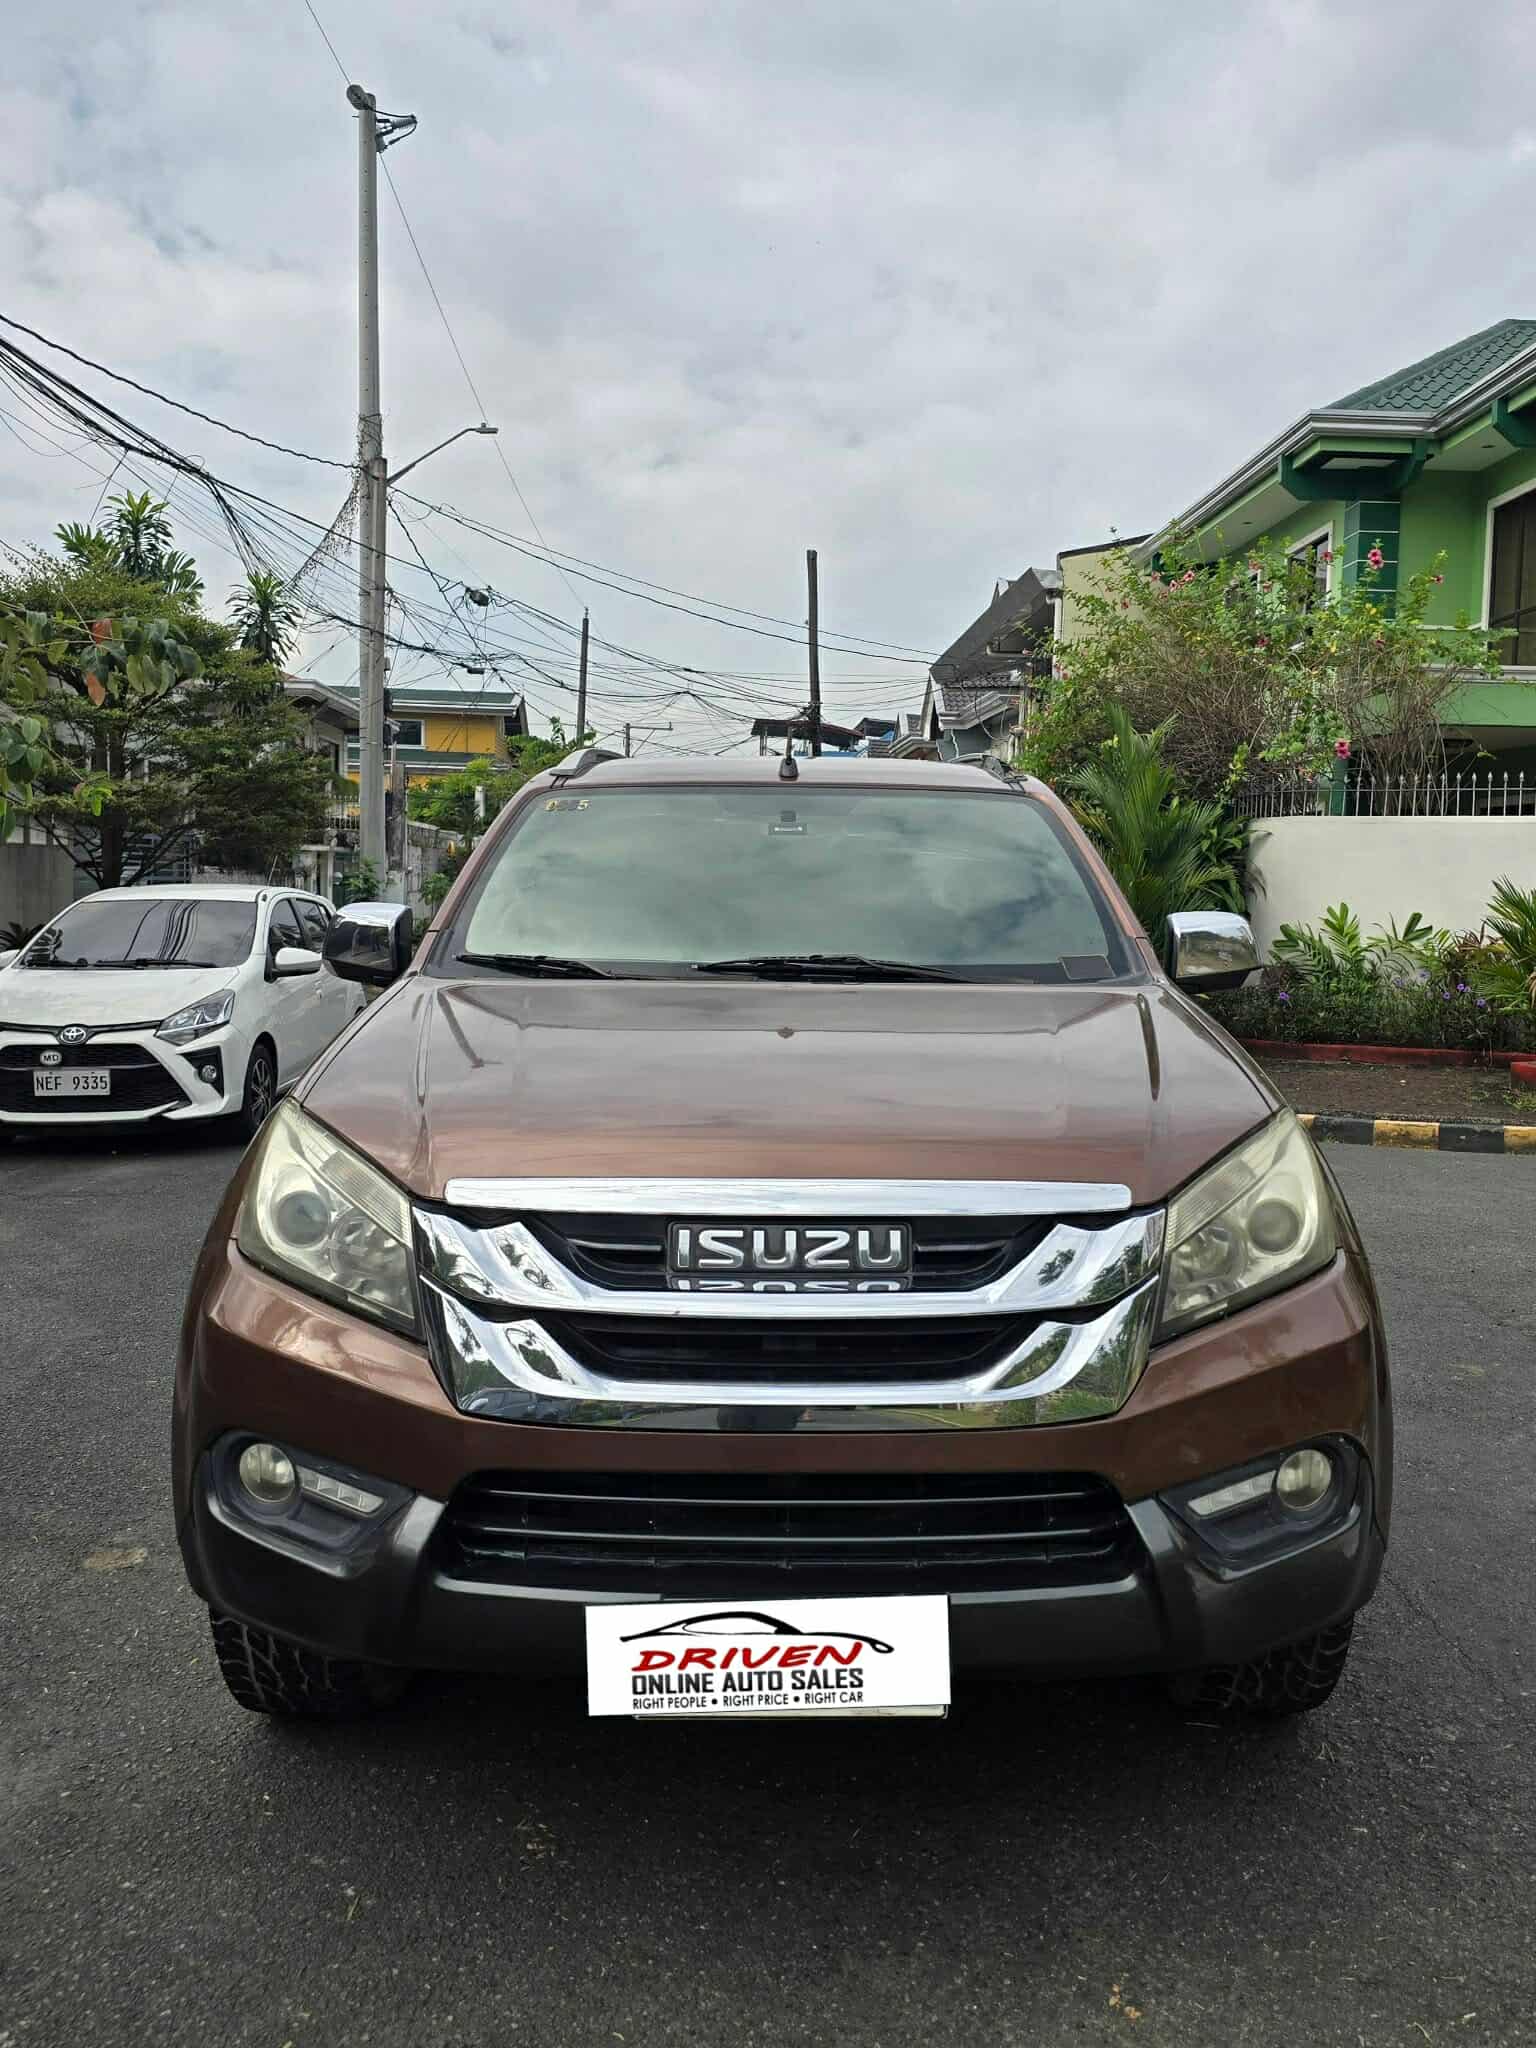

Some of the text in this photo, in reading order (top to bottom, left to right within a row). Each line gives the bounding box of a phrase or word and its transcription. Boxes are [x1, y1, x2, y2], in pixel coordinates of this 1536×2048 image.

[36, 1075, 108, 1090] NEF 9335
[677, 1229, 902, 1269] ISUZU
[631, 1641, 864, 1672] DRIVEN
[632, 1668, 864, 1695] ONLINE AUTO SALES
[632, 1691, 864, 1709] RIGHT PEOPLE RIGHT PRICE RIGHT CAR
